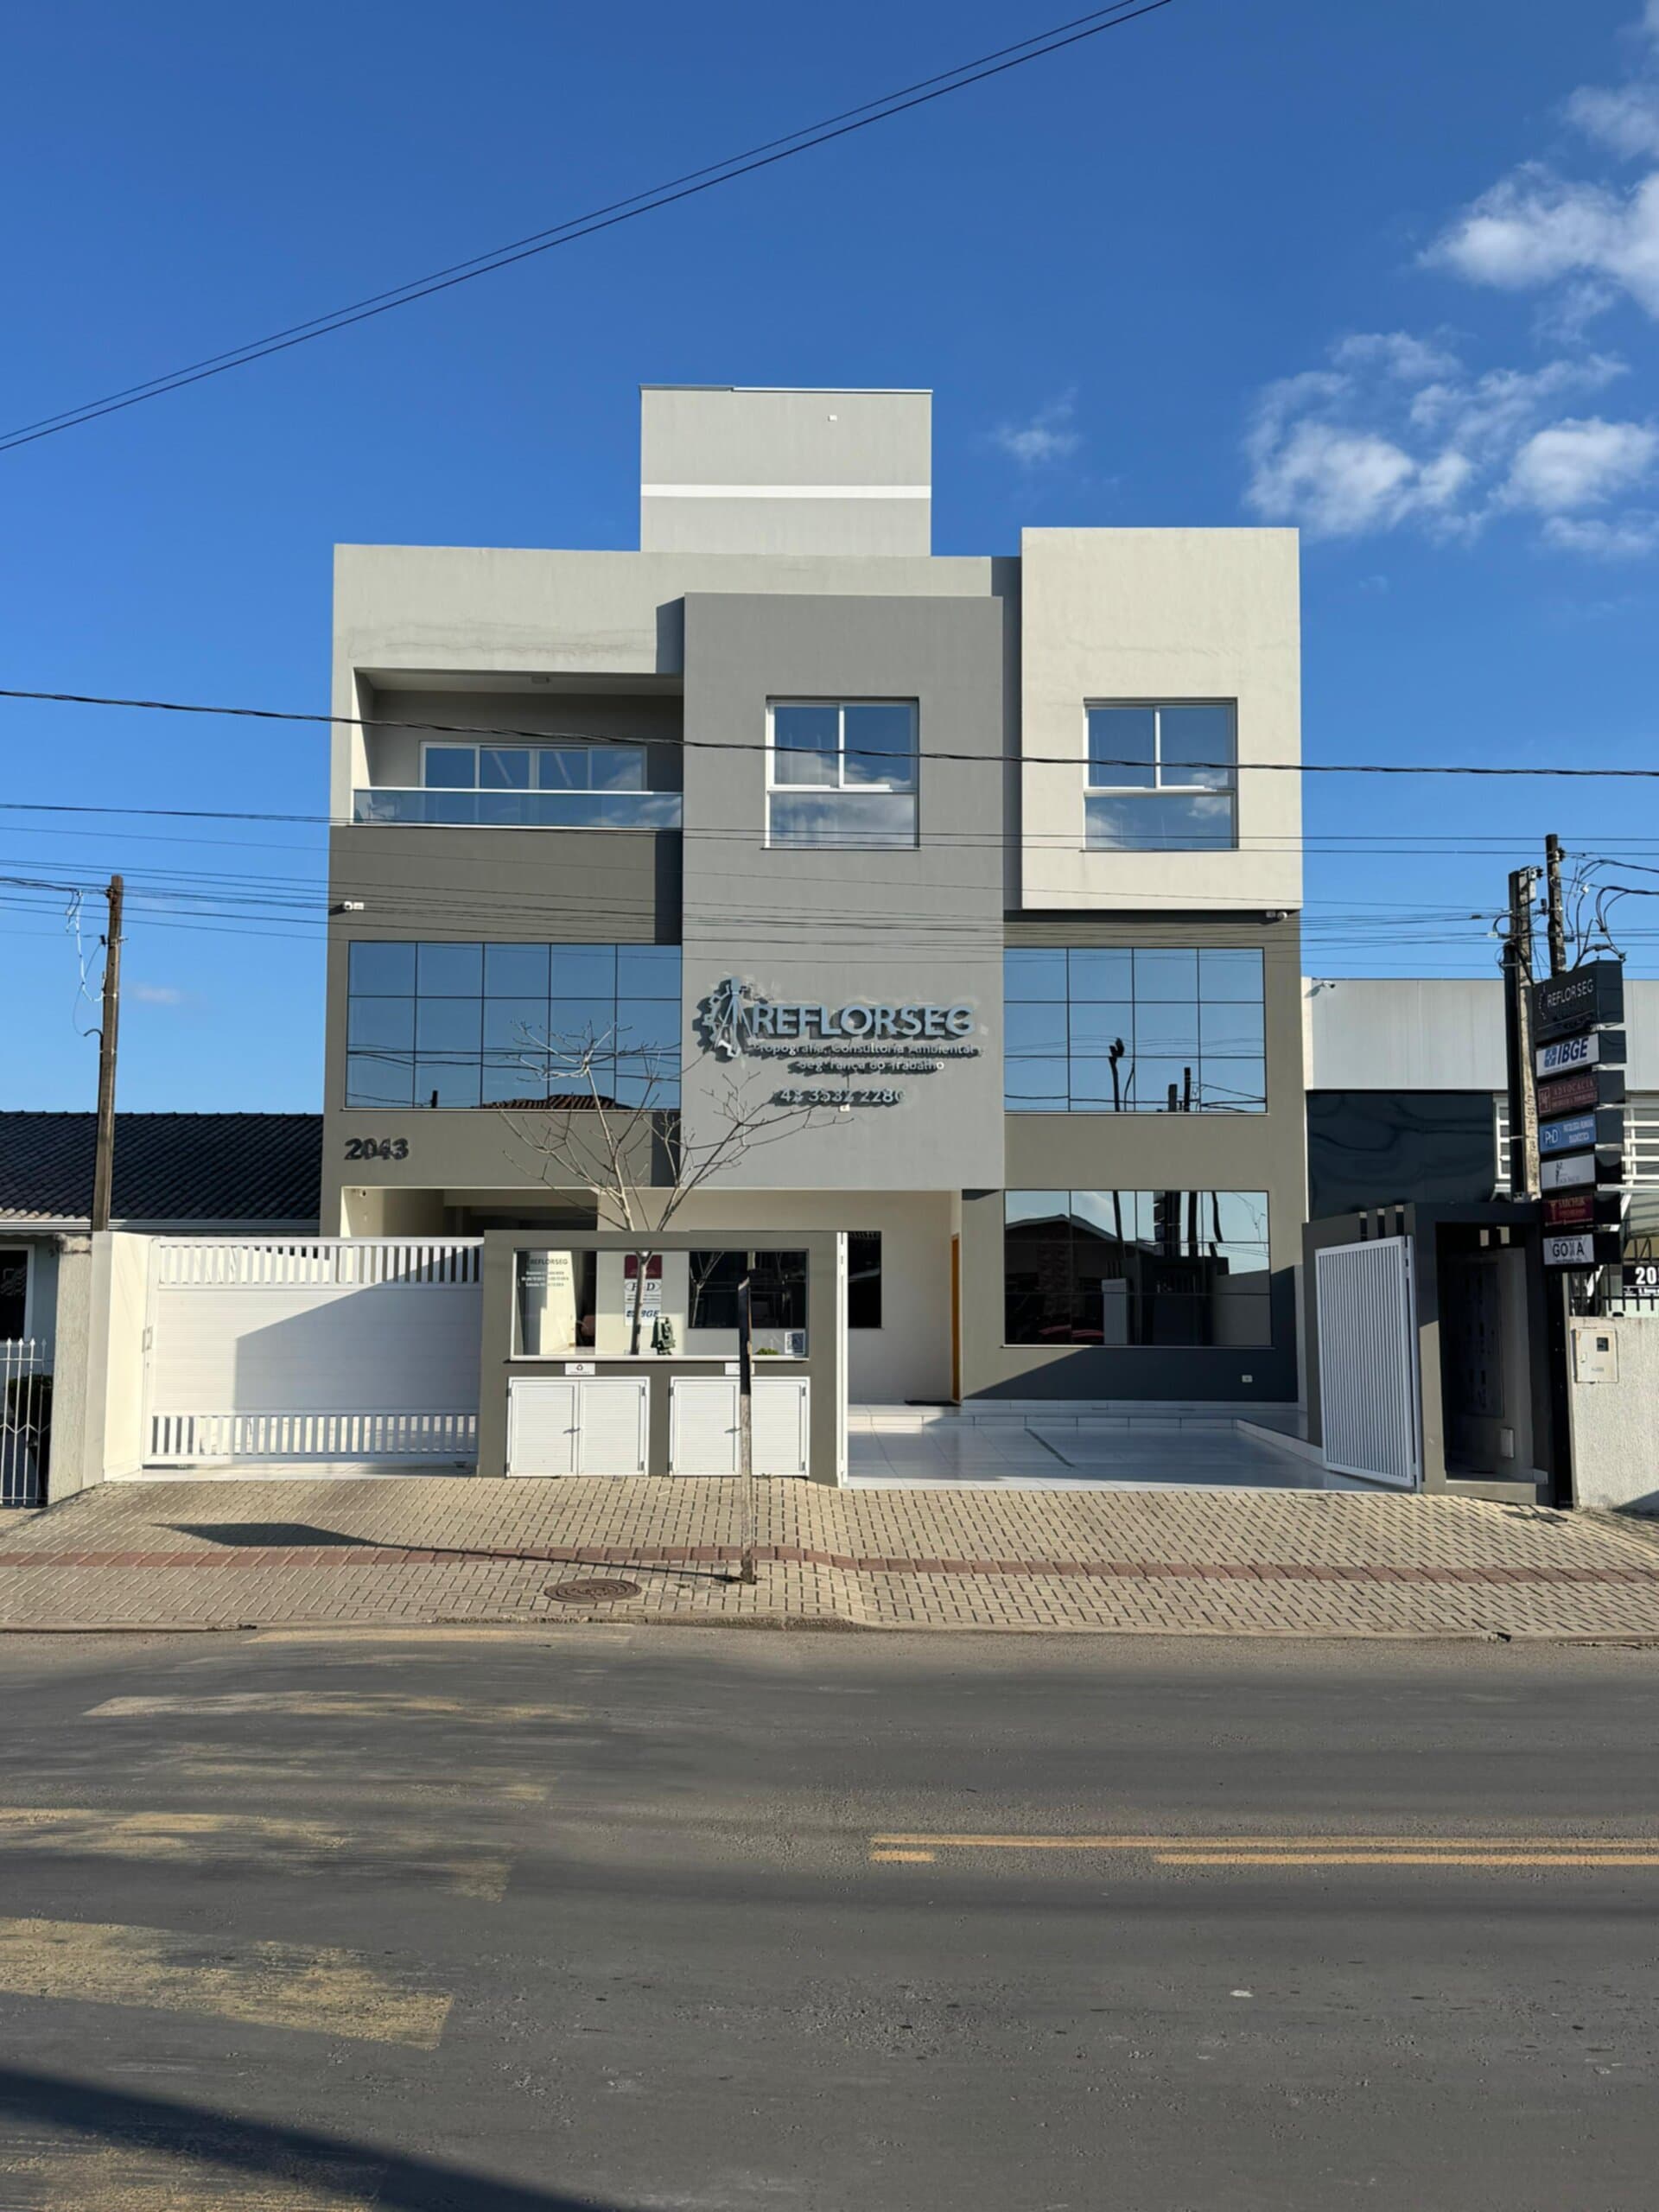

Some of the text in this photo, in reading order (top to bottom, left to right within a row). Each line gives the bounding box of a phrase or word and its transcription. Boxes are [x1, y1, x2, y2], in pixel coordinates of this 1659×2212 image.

[1547, 978, 1594, 1007] REFLORSEG
[752, 1005, 976, 1036] REFLORSEG
[1557, 1037, 1589, 1065] IBGE
[344, 1137, 410, 1160] 2043
[1635, 1267, 1659, 1285] 20
